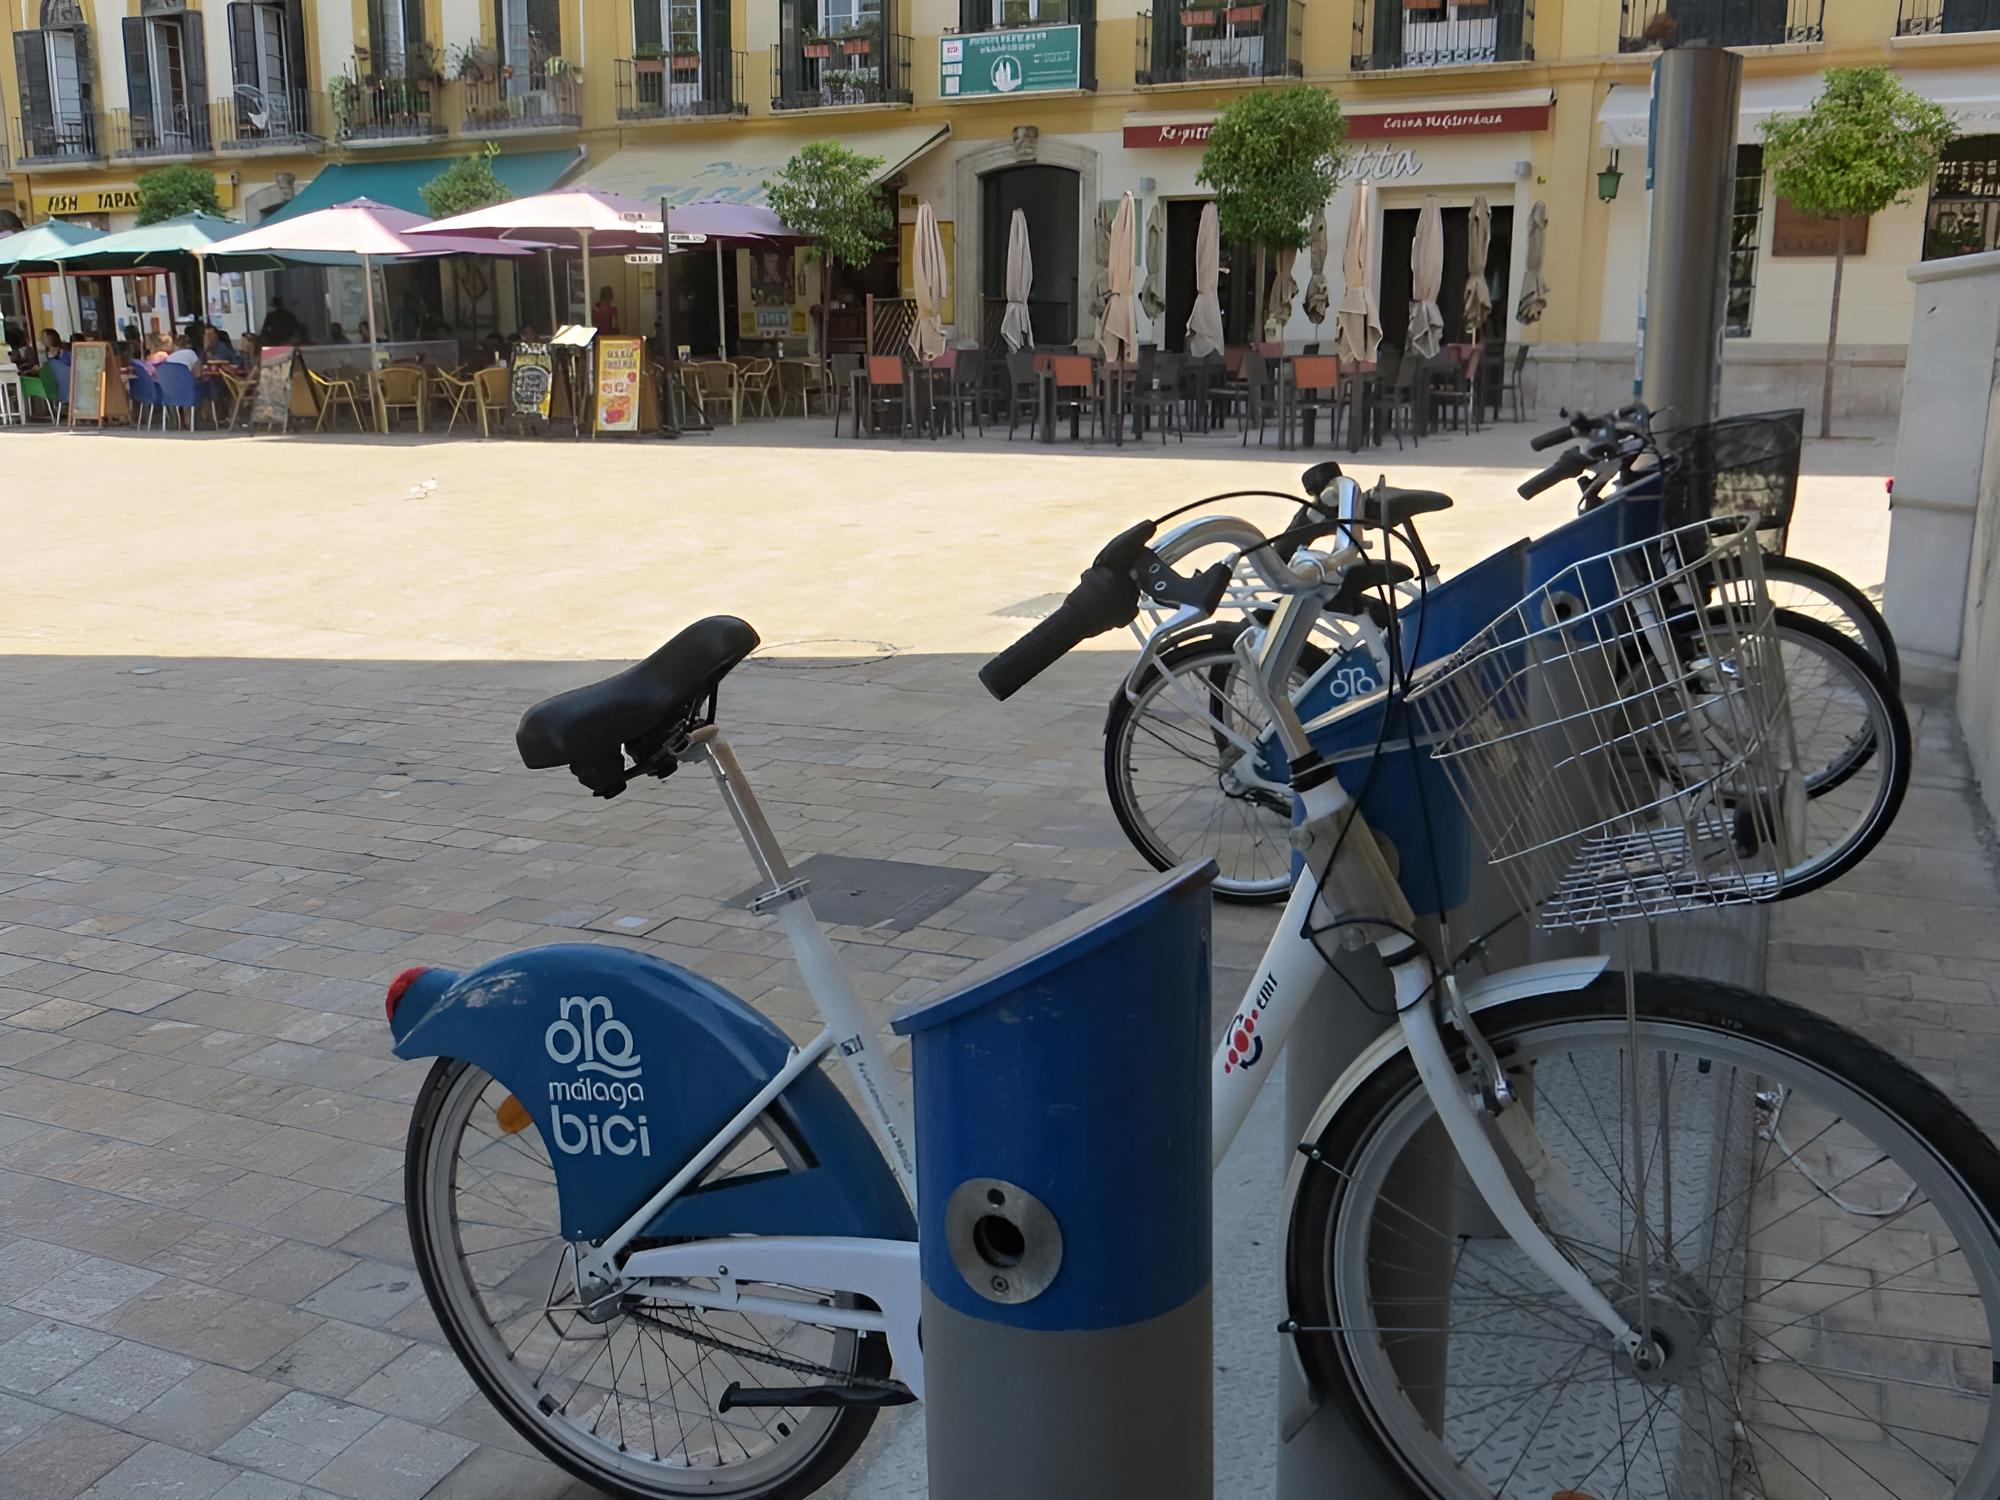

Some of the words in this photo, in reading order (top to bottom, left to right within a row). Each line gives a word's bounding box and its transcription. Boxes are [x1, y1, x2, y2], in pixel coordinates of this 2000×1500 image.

[47, 194, 78, 212] FISH
[549, 1077, 645, 1111] málaga
[551, 1104, 650, 1157] bici
